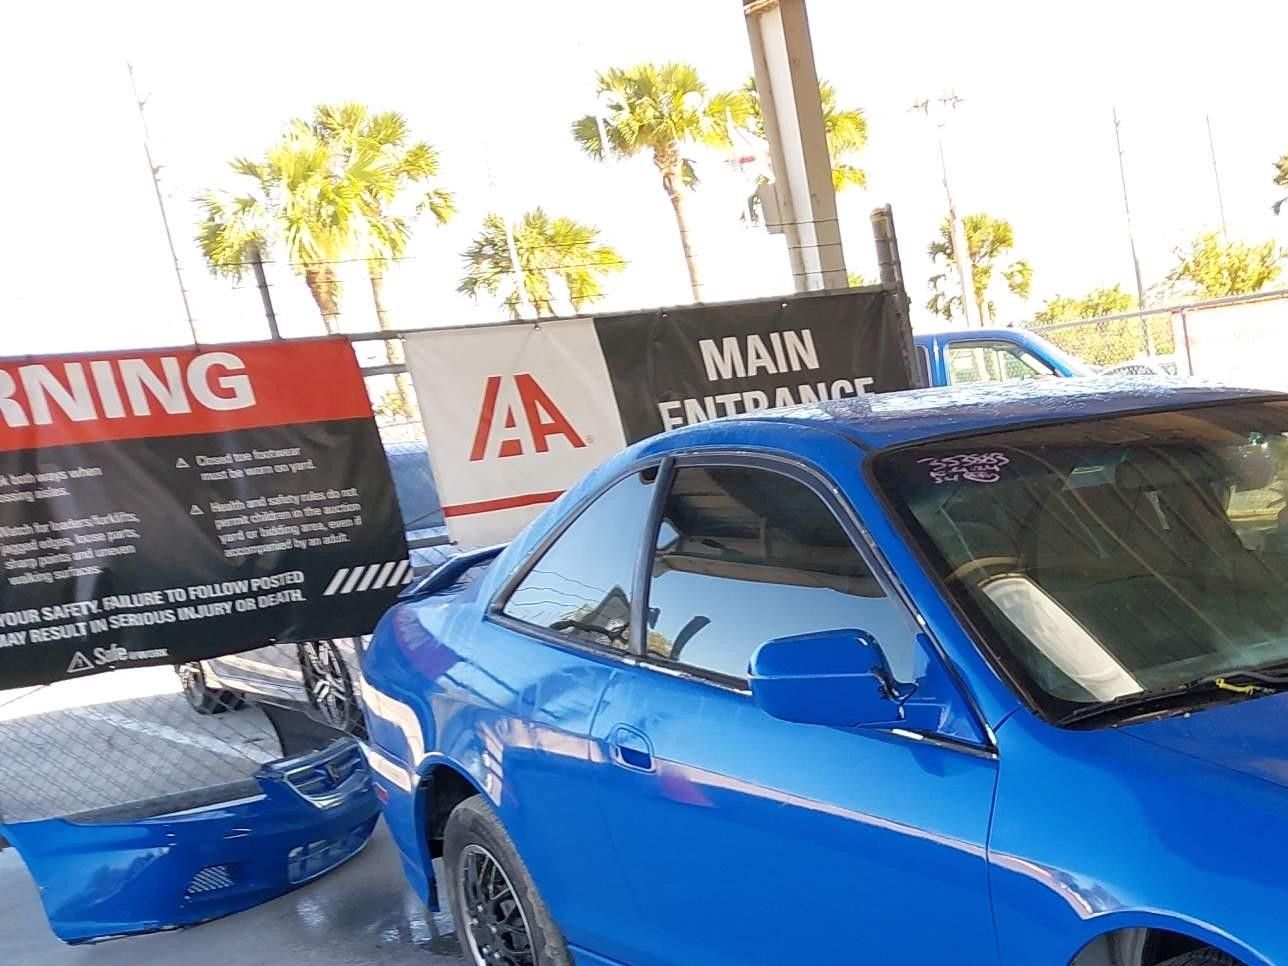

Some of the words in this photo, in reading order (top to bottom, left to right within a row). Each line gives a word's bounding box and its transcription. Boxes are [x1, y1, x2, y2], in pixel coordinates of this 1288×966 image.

[699, 329, 820, 381] MAIN
[102, 591, 166, 611] FAILURE
[164, 588, 187, 603] TO
[187, 580, 249, 600] FOLLOW
[250, 570, 305, 591] POSTED
[29, 622, 88, 643] RESULT
[89, 618, 109, 634] IN
[108, 609, 177, 629] SERIOUS
[176, 601, 233, 621] INJURY
[234, 598, 257, 612] OR
